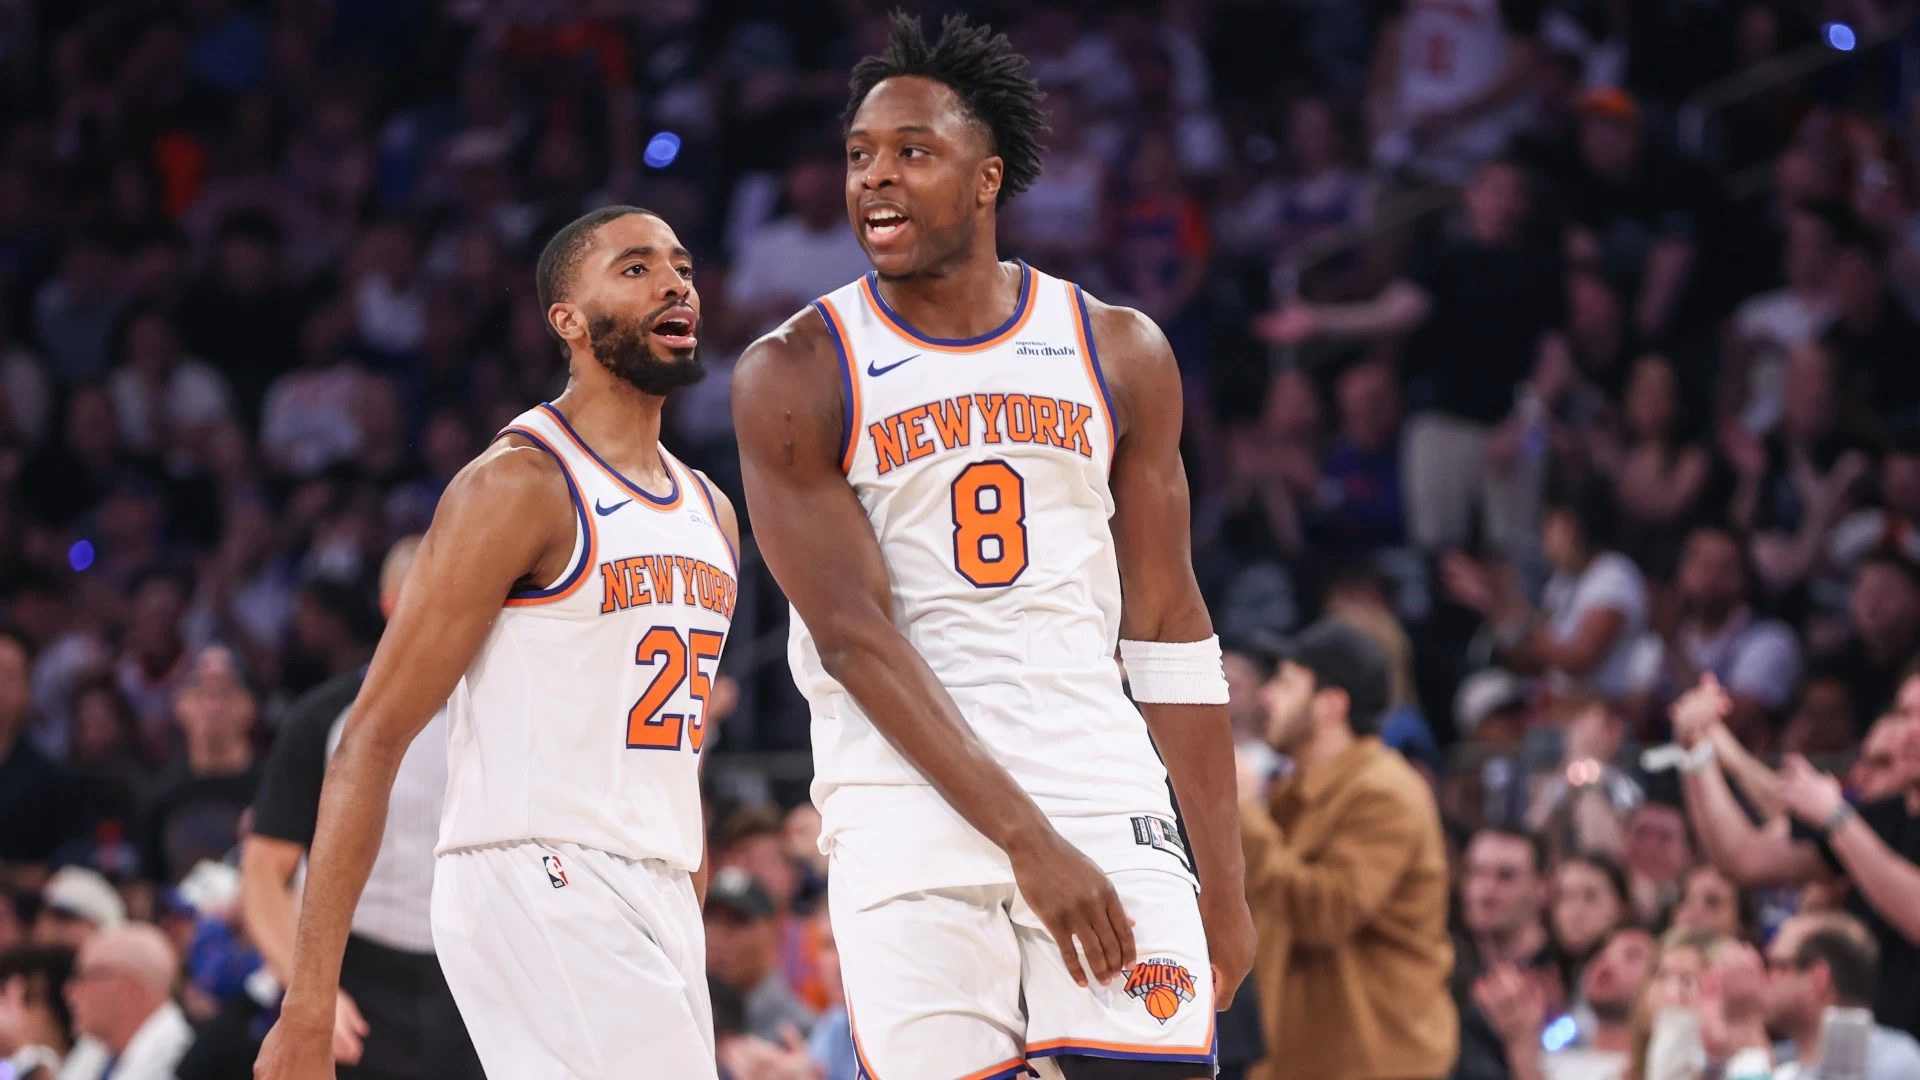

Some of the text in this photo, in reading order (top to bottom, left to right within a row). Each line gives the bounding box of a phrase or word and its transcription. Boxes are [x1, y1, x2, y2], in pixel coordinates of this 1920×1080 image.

[1016, 346, 1076, 356] abu dhabi
[867, 393, 1093, 477] NEW YORK
[950, 459, 1030, 589] 8
[599, 554, 673, 615] NEW
[625, 625, 724, 754] 25
[1123, 962, 1196, 1000] KNICKS
